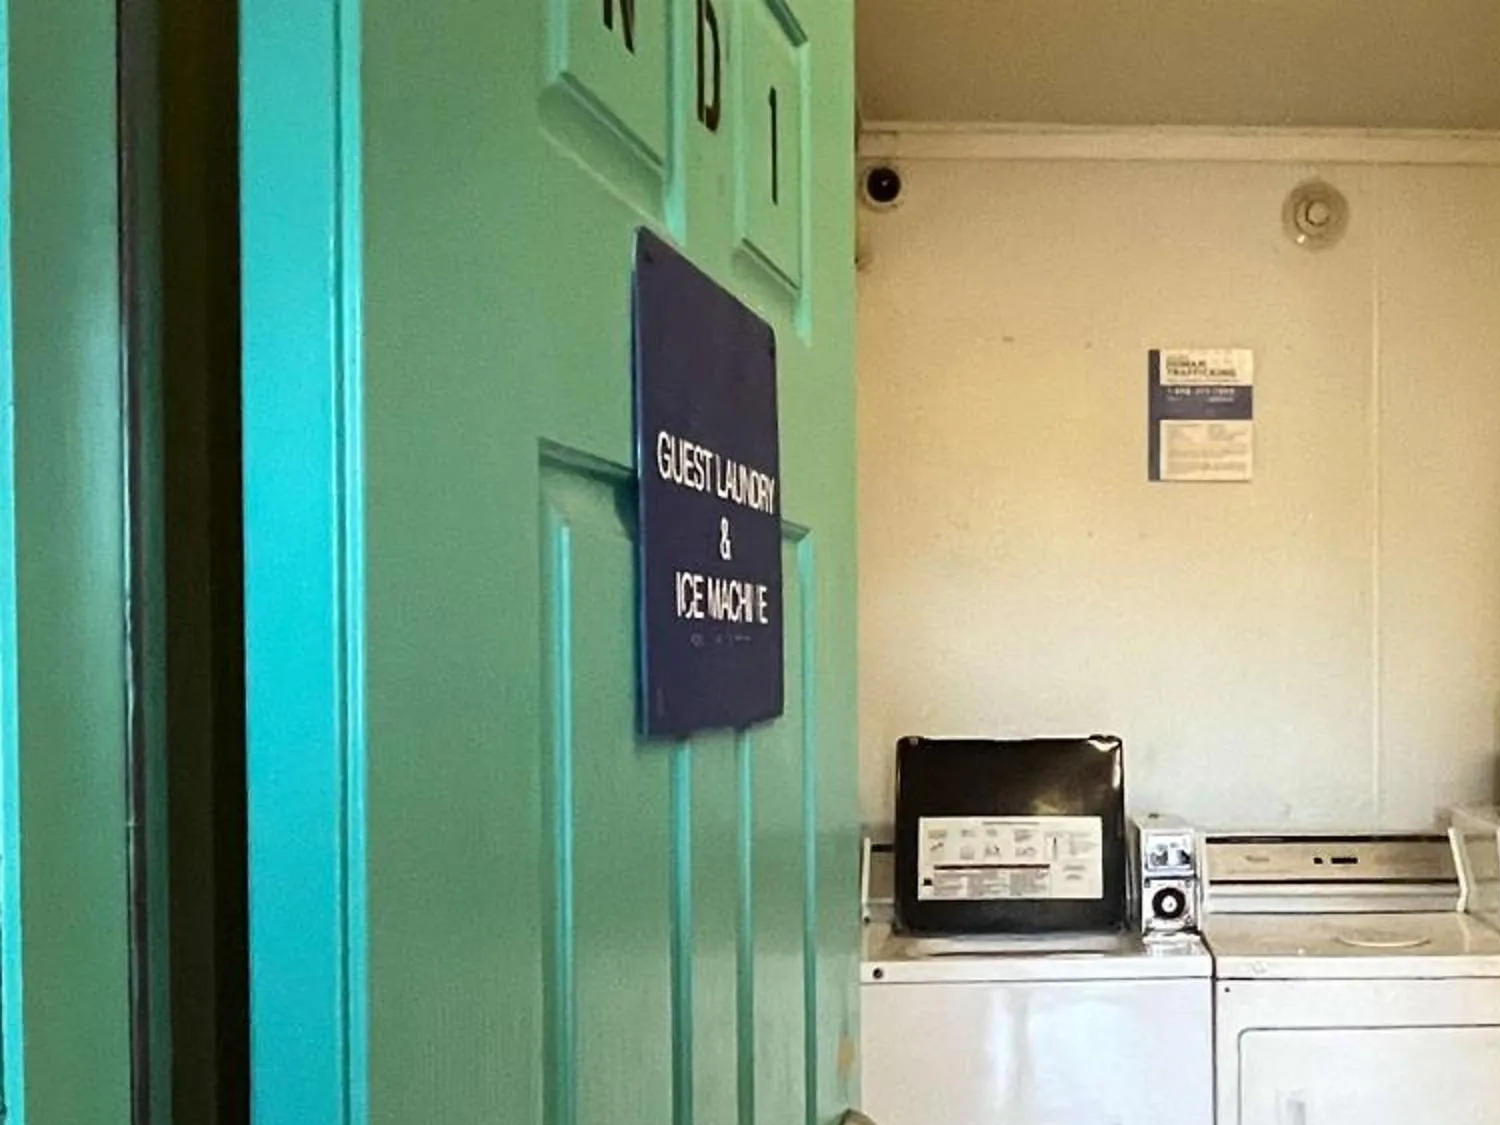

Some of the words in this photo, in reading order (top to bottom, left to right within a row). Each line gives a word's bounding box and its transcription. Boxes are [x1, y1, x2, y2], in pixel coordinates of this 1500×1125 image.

[657, 431, 713, 492] GUEST
[715, 453, 775, 514] LAUNDRY
[719, 516, 732, 561] &
[675, 570, 705, 619] ICE
